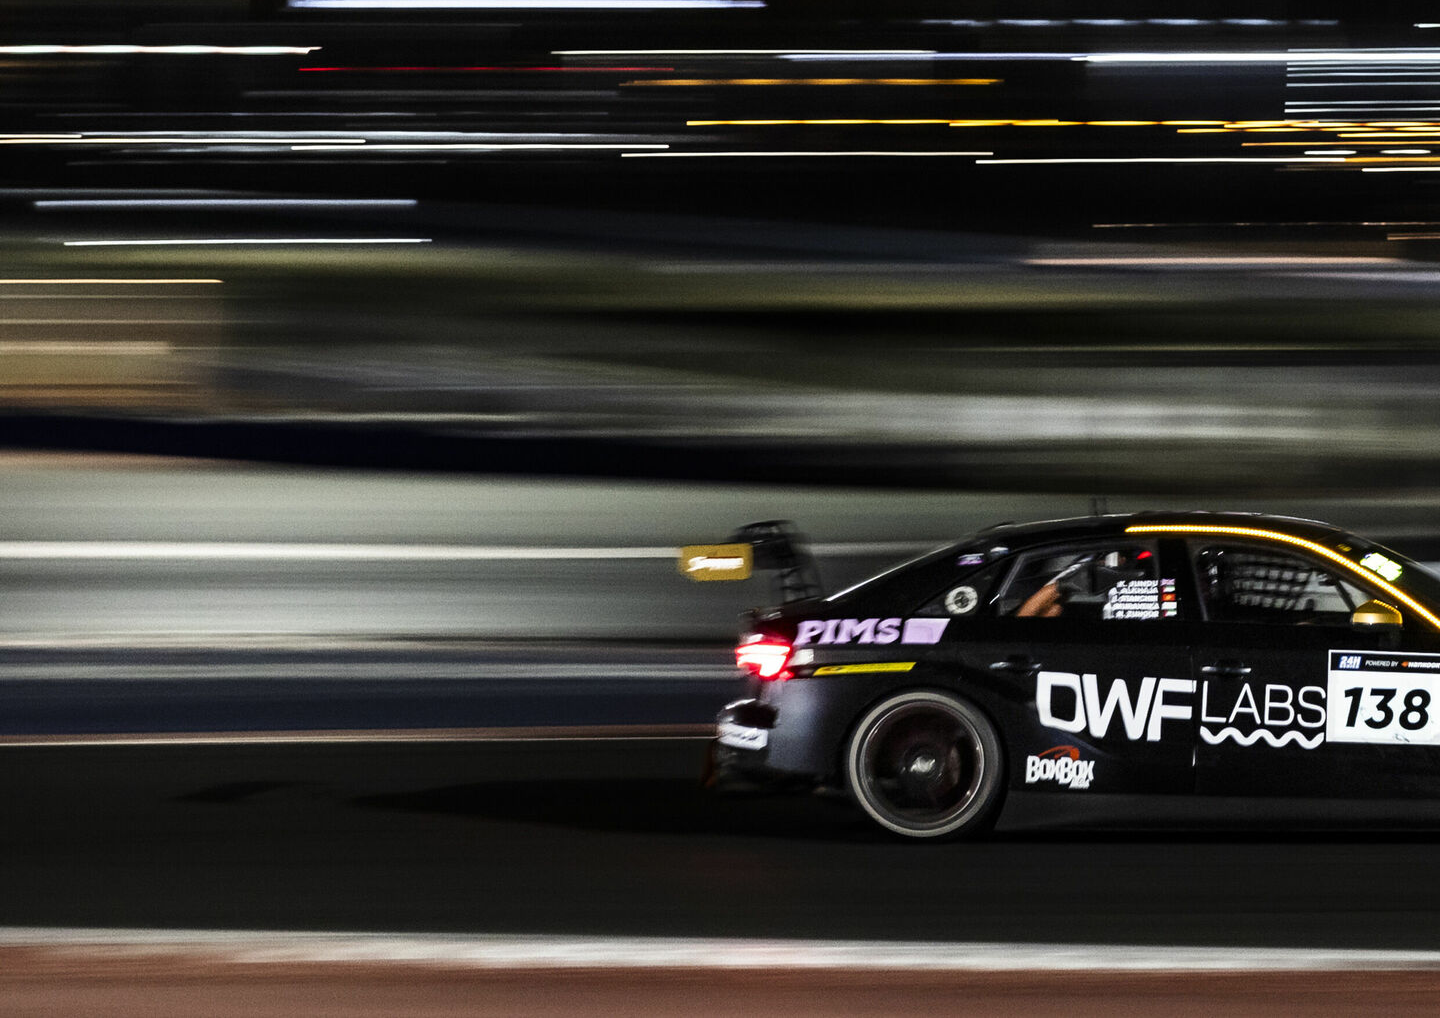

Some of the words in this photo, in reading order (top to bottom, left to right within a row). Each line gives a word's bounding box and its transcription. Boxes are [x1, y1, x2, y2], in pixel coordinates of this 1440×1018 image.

[792, 618, 902, 645] PIMS
[1201, 680, 1327, 728] LABS
[1344, 686, 1432, 731] 138
